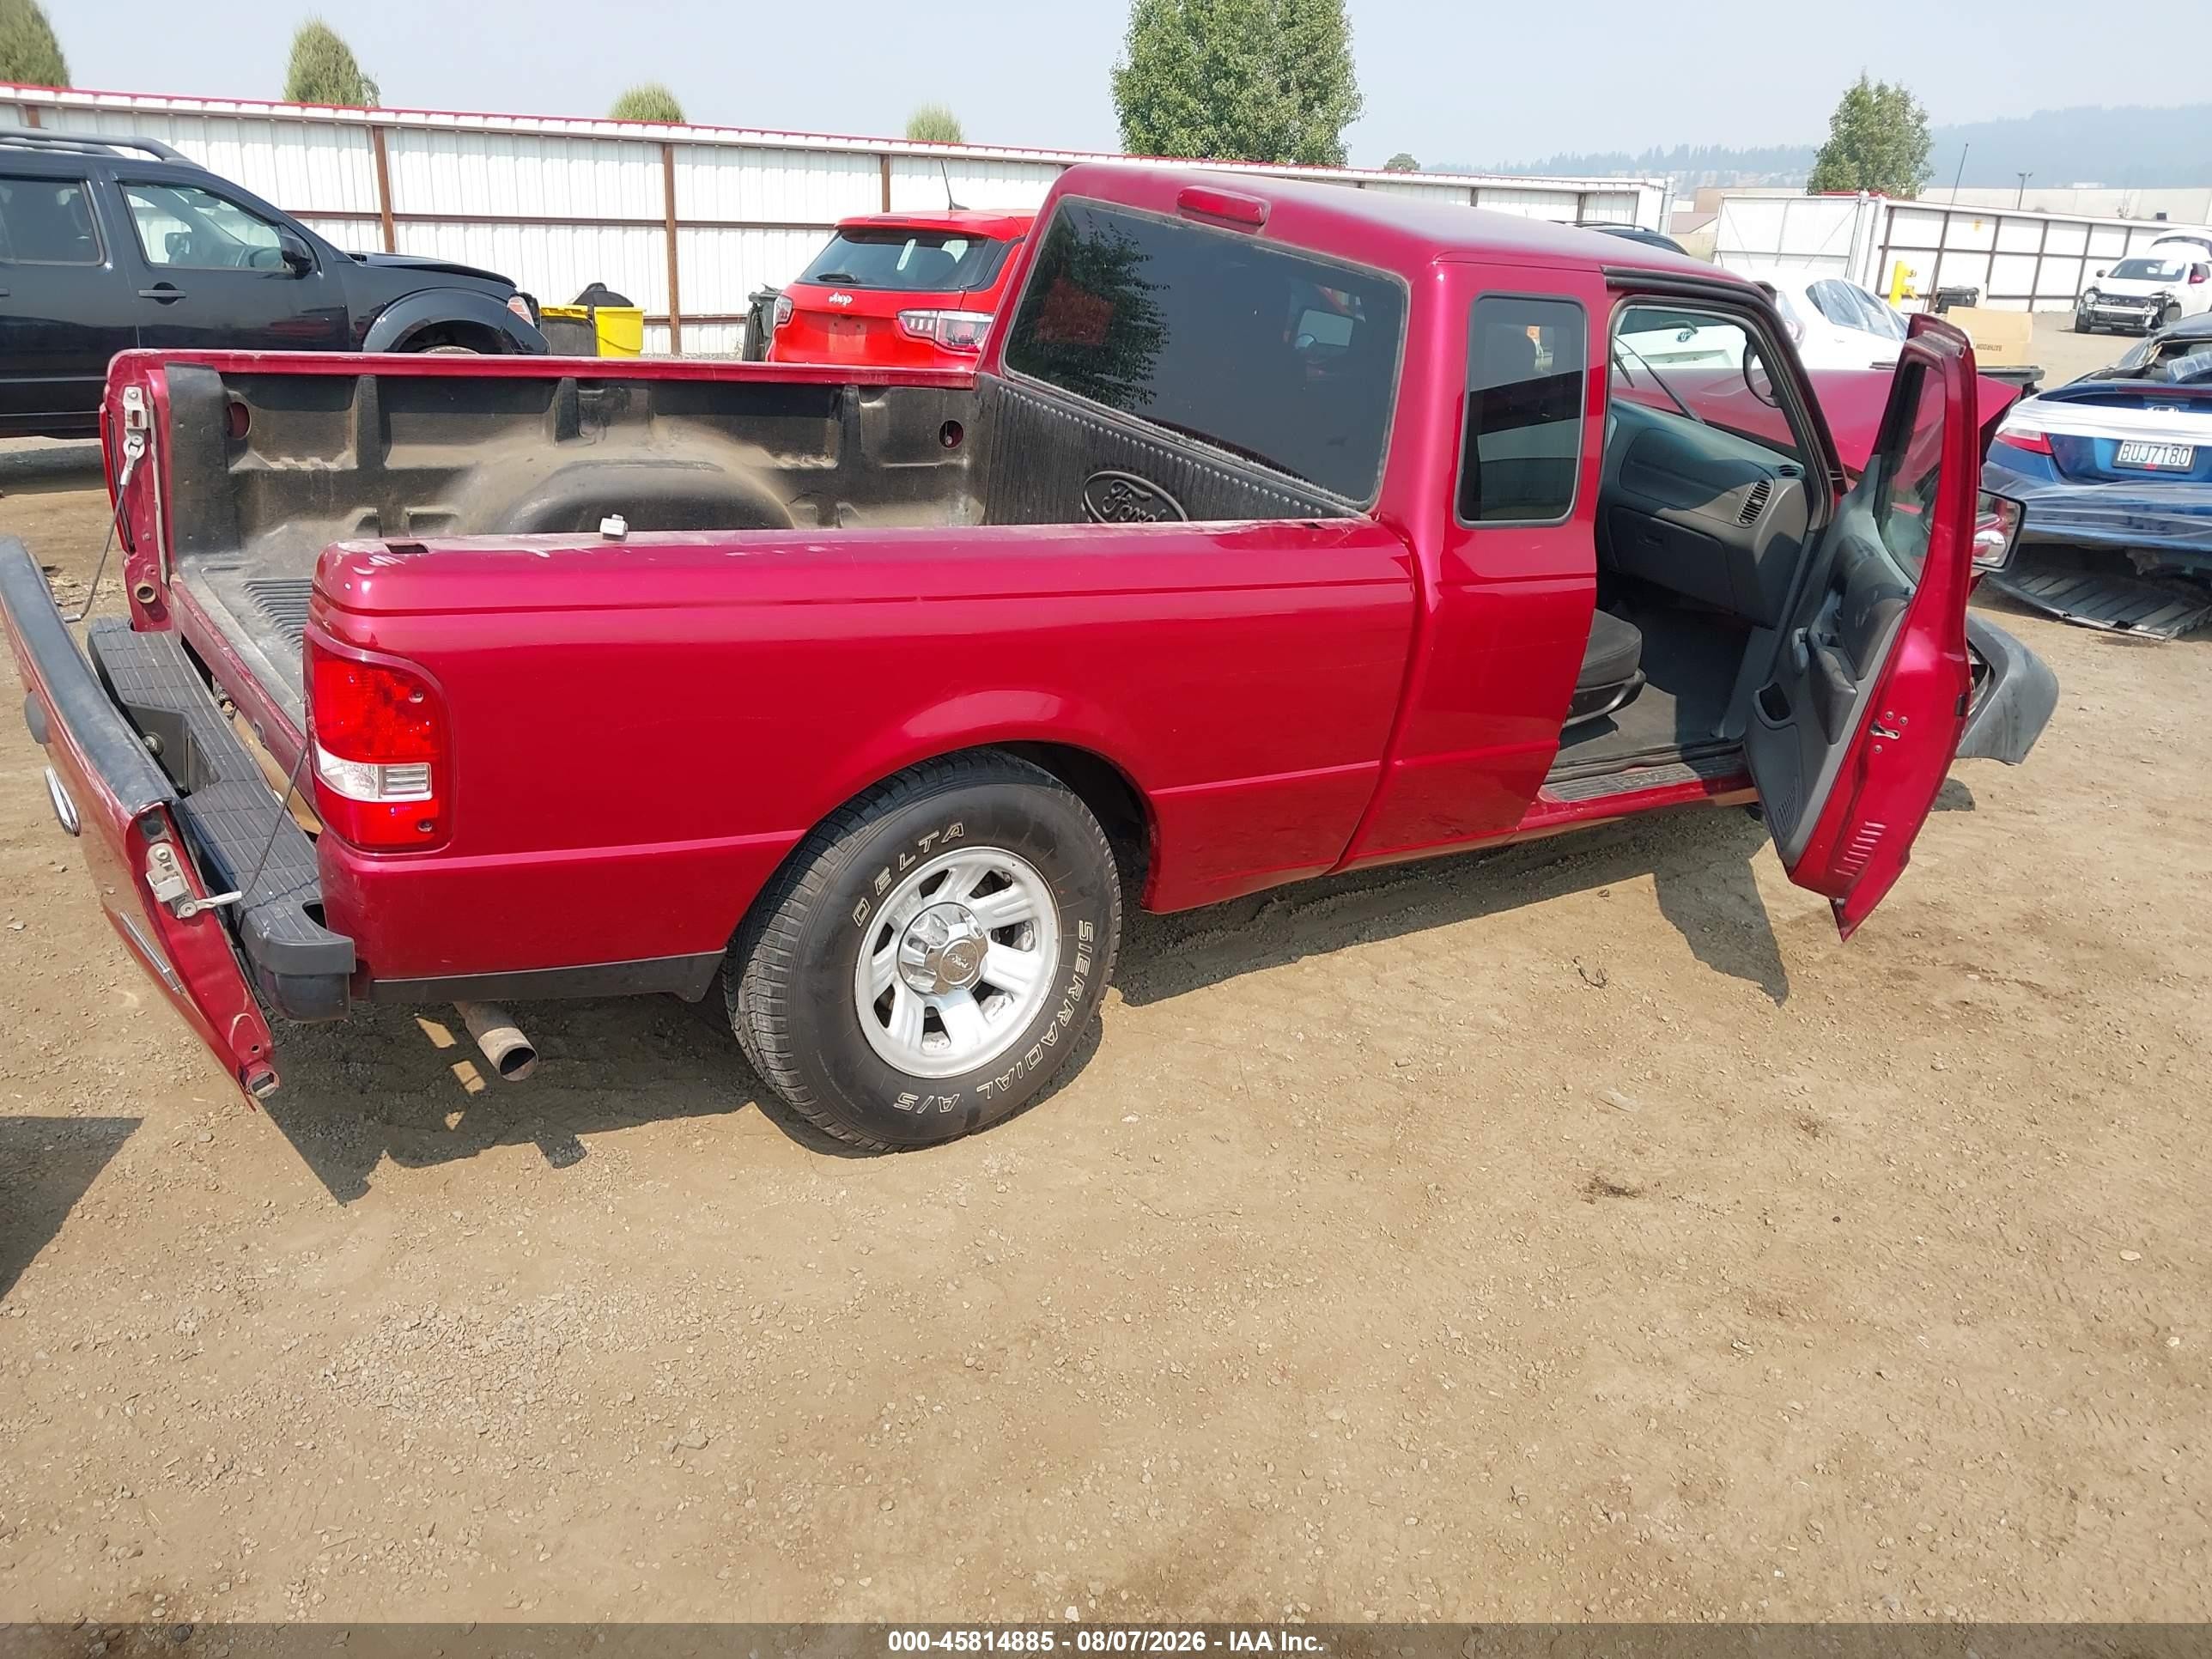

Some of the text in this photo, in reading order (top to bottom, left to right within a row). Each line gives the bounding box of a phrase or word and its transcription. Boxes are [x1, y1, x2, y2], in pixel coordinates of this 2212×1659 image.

[2121, 443, 2190, 465] BUJ7180
[852, 822, 965, 927] DELTA
[893, 920, 1095, 1115] SIERRADIAL A/S
